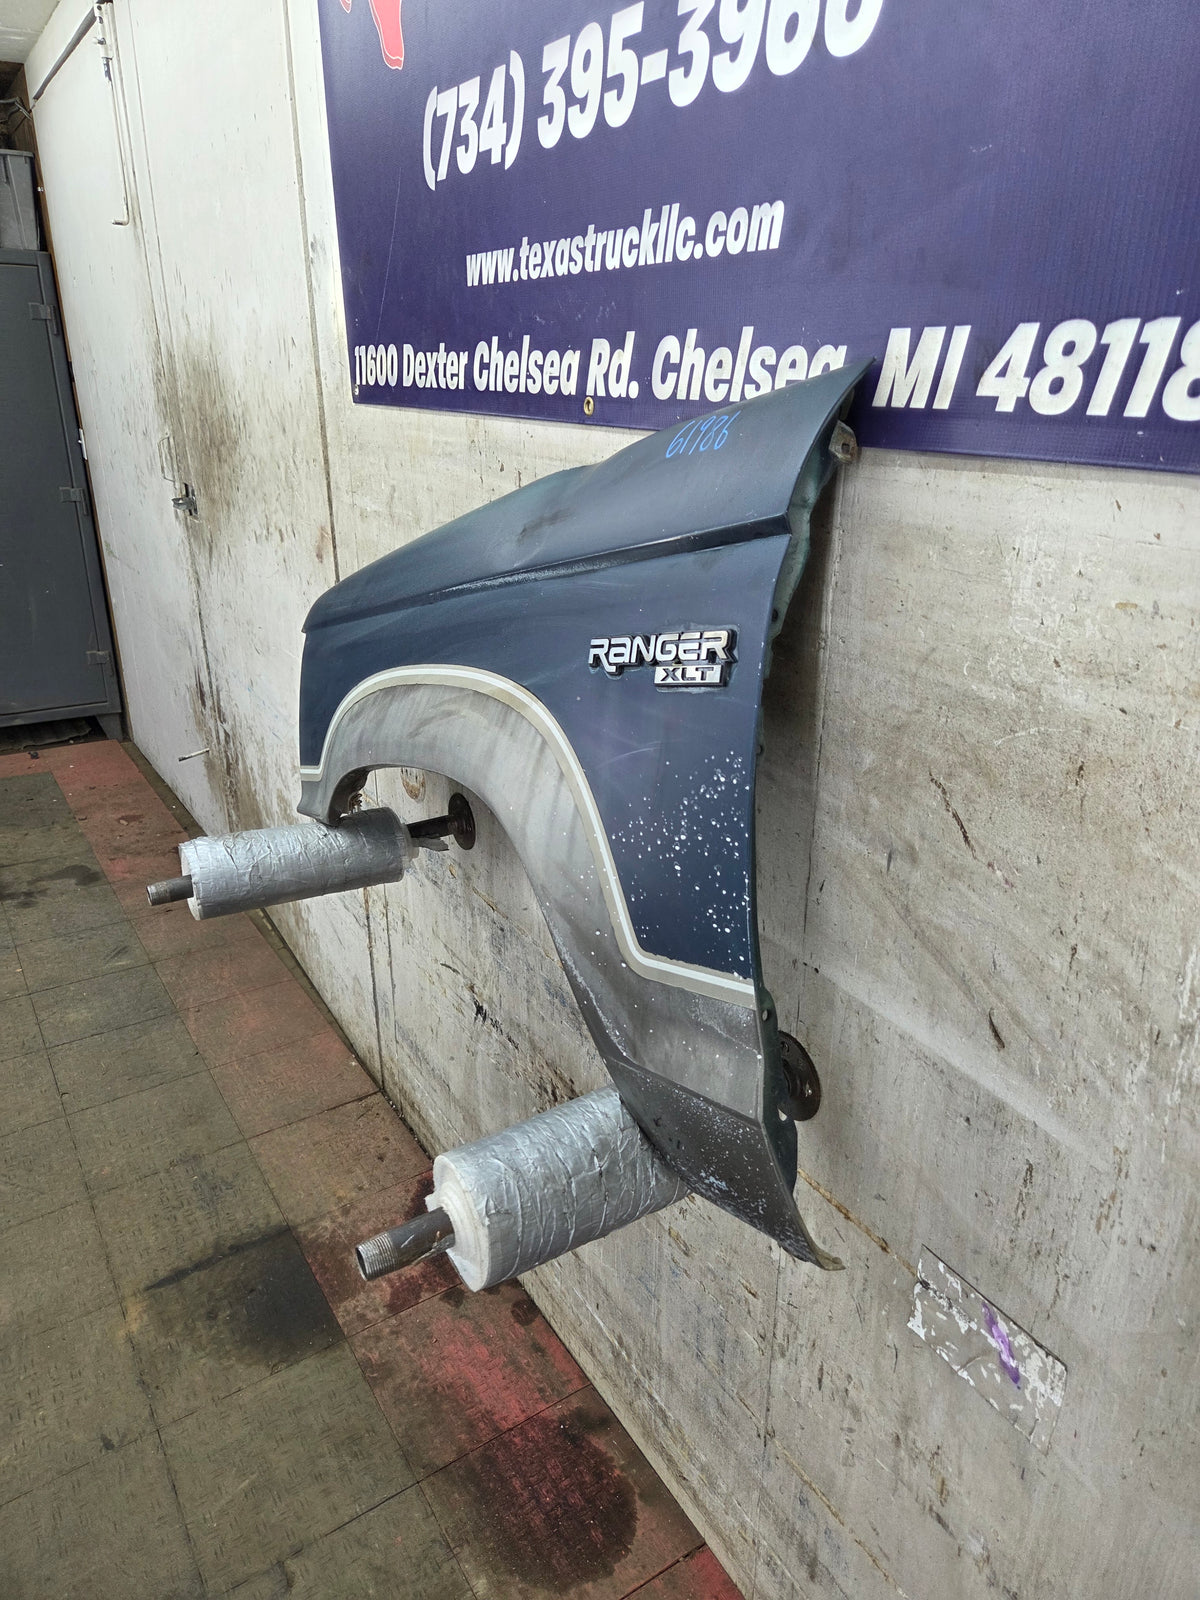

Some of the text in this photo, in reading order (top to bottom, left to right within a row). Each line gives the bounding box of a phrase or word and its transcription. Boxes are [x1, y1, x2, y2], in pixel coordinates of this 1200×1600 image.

[422, 50, 526, 191] (734)
[465, 200, 786, 287] www.texastruckllc.com
[354, 343, 398, 387] 11600
[402, 342, 468, 390] Dexter
[473, 334, 581, 396] Chelsea
[585, 330, 640, 399] Rd.
[871, 325, 972, 410] MI
[588, 630, 731, 673] RANGER
[660, 666, 715, 682] XLT
